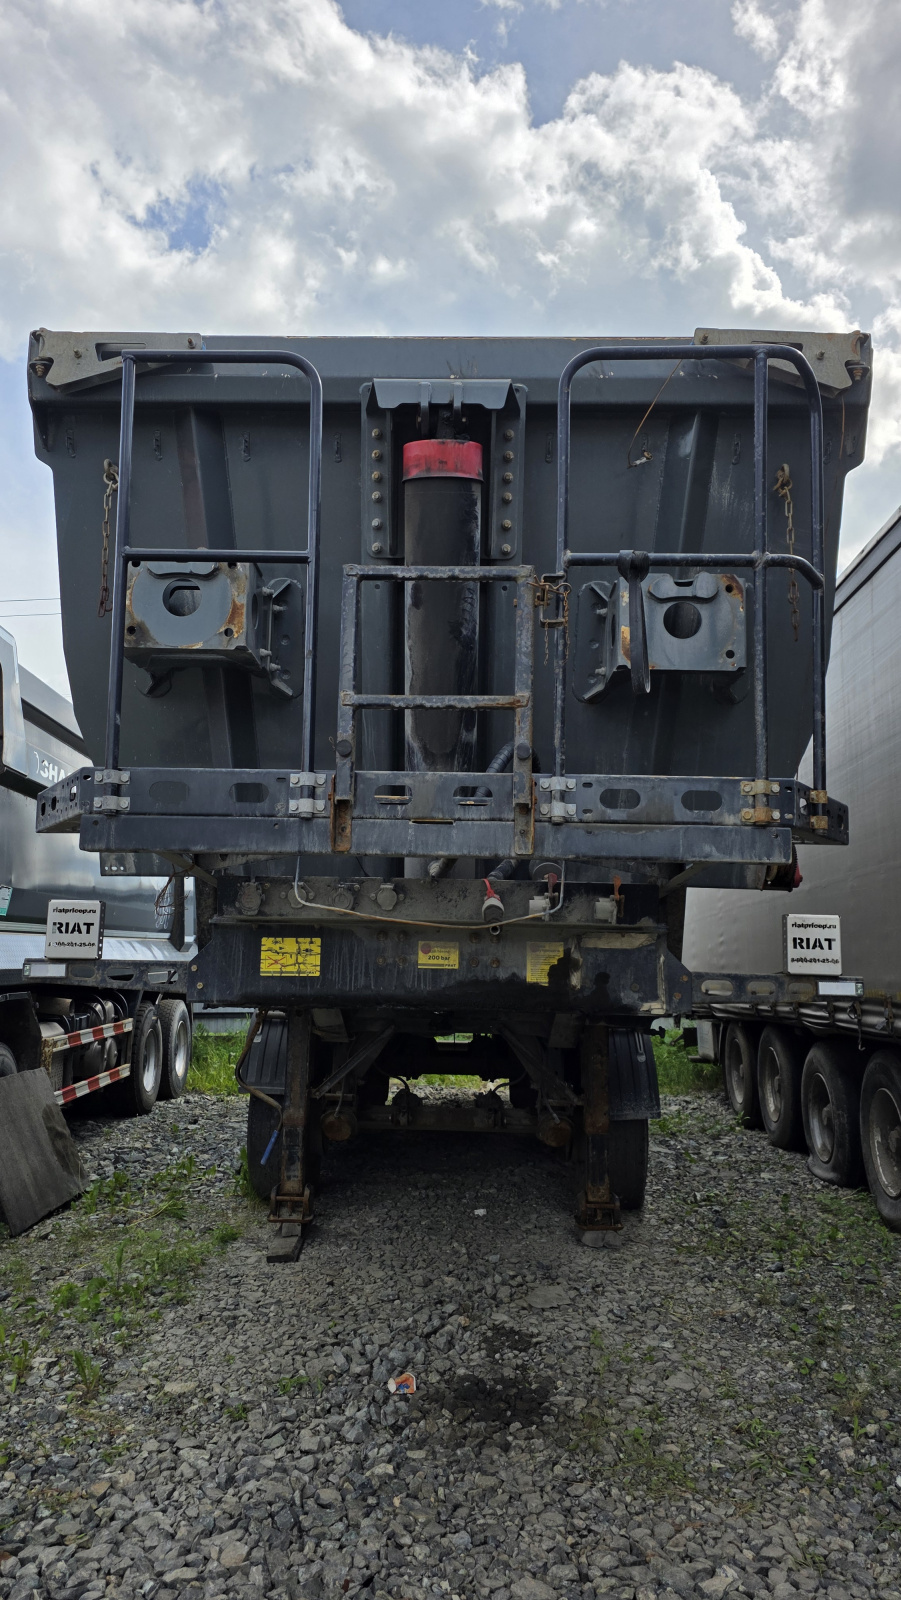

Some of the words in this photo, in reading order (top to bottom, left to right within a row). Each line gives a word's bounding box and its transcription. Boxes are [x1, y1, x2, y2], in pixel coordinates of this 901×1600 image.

[40, 759, 72, 783] SHA
[52, 922, 95, 934] RIAT
[792, 937, 836, 950] RIAT
